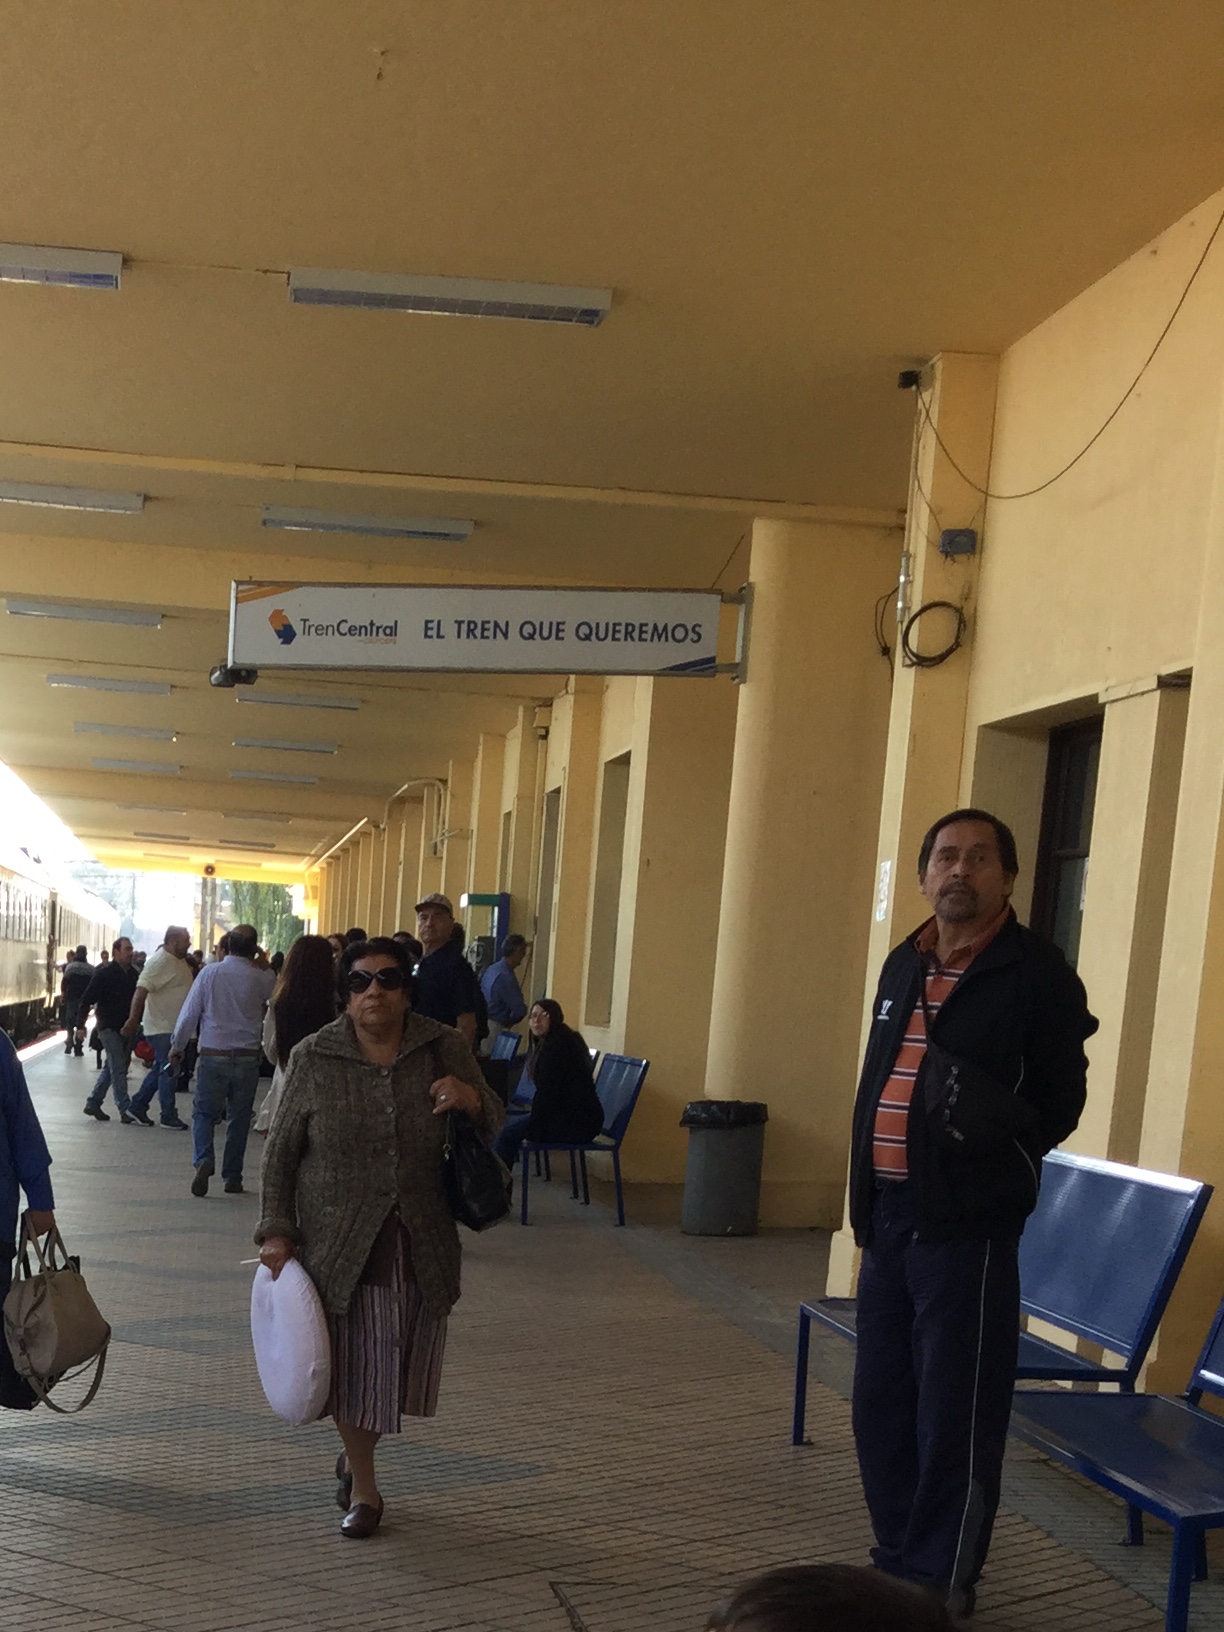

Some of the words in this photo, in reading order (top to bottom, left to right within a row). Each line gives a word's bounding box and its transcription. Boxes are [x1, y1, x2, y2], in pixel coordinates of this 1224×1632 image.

[299, 618, 398, 638] TrenCentral
[423, 619, 446, 640] EL
[454, 619, 510, 640] TREN
[519, 620, 566, 641] QUE
[575, 621, 703, 643] QUEREMOS
